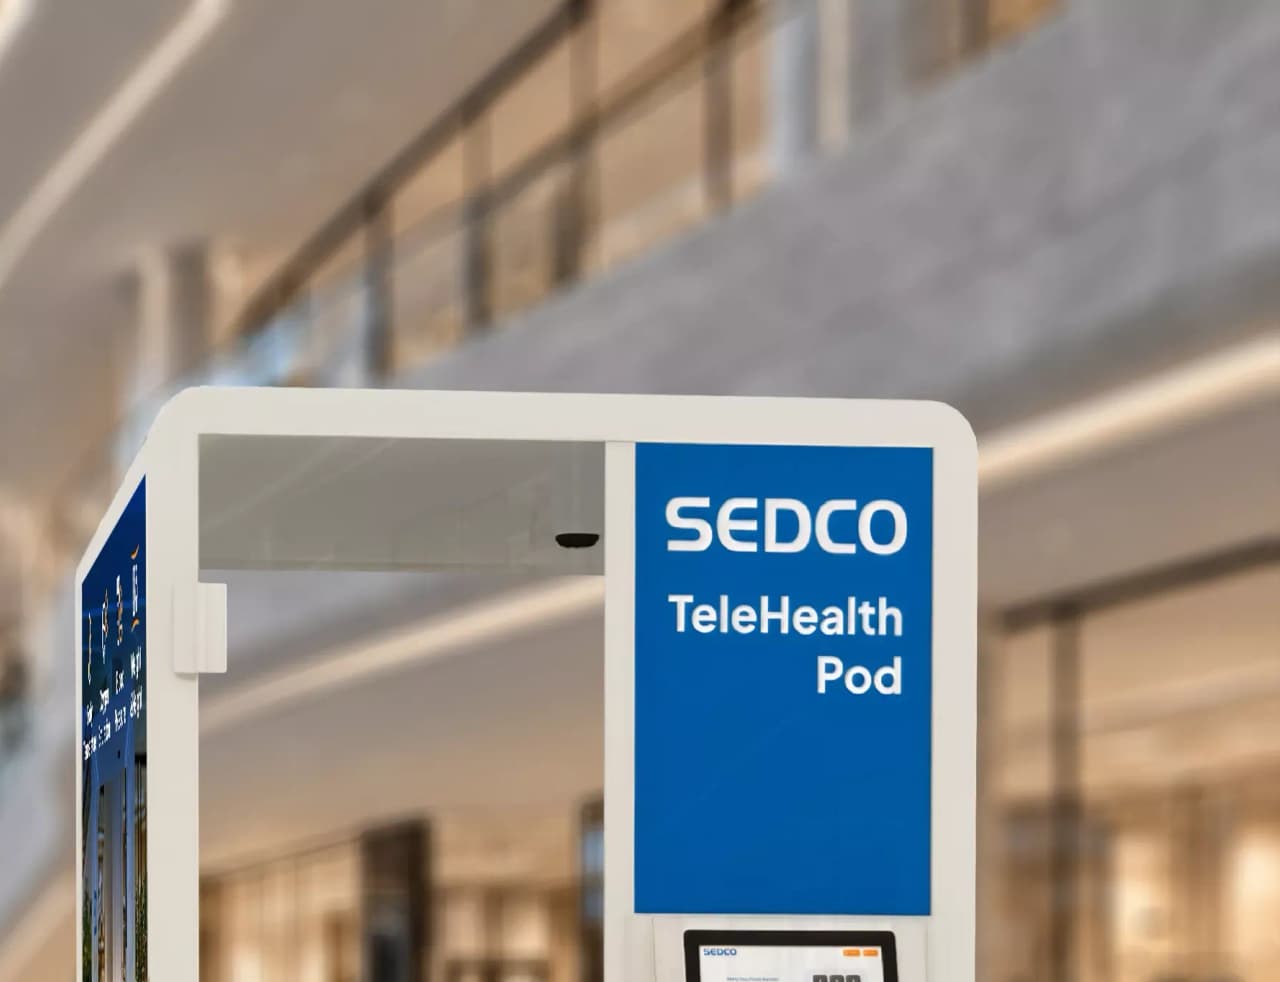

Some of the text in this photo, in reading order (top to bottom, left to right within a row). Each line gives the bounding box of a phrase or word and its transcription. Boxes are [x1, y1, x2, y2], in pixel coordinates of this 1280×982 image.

[665, 497, 908, 556] SEDCO
[668, 594, 903, 637] TeleHealth
[817, 656, 902, 695] Pod
[703, 948, 737, 956] SEDCO
